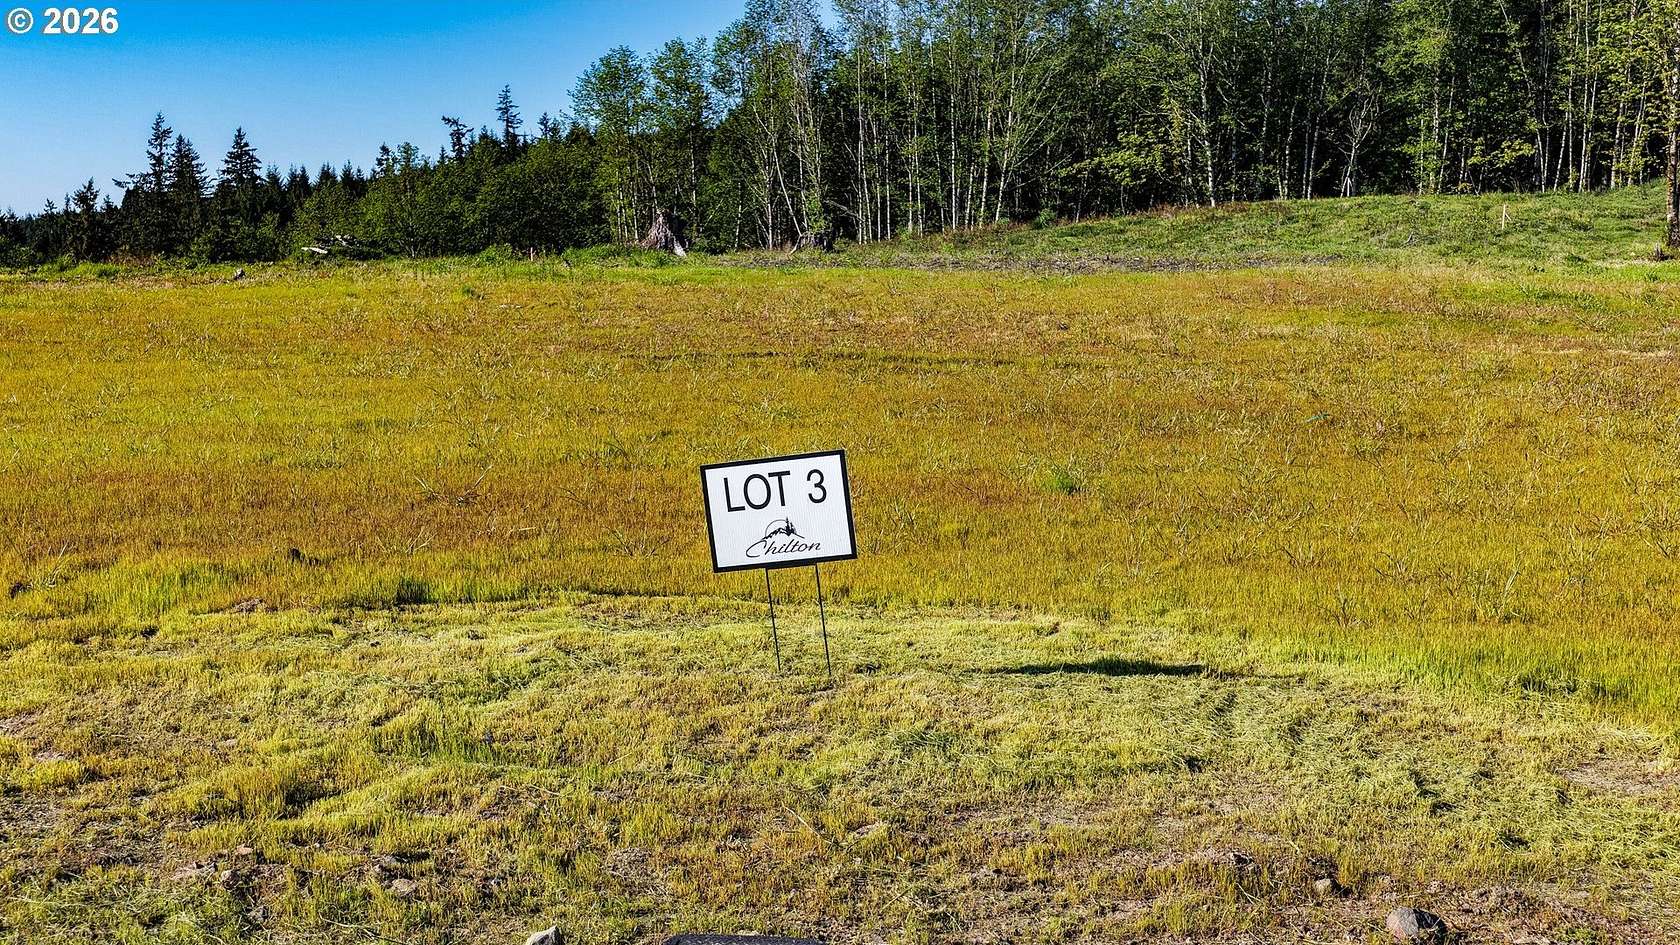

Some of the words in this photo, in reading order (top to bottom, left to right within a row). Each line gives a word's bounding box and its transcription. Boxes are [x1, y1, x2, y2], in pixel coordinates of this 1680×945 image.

[723, 470, 791, 512] LOT
[806, 469, 827, 503] 3
[745, 538, 822, 558] Chilton
